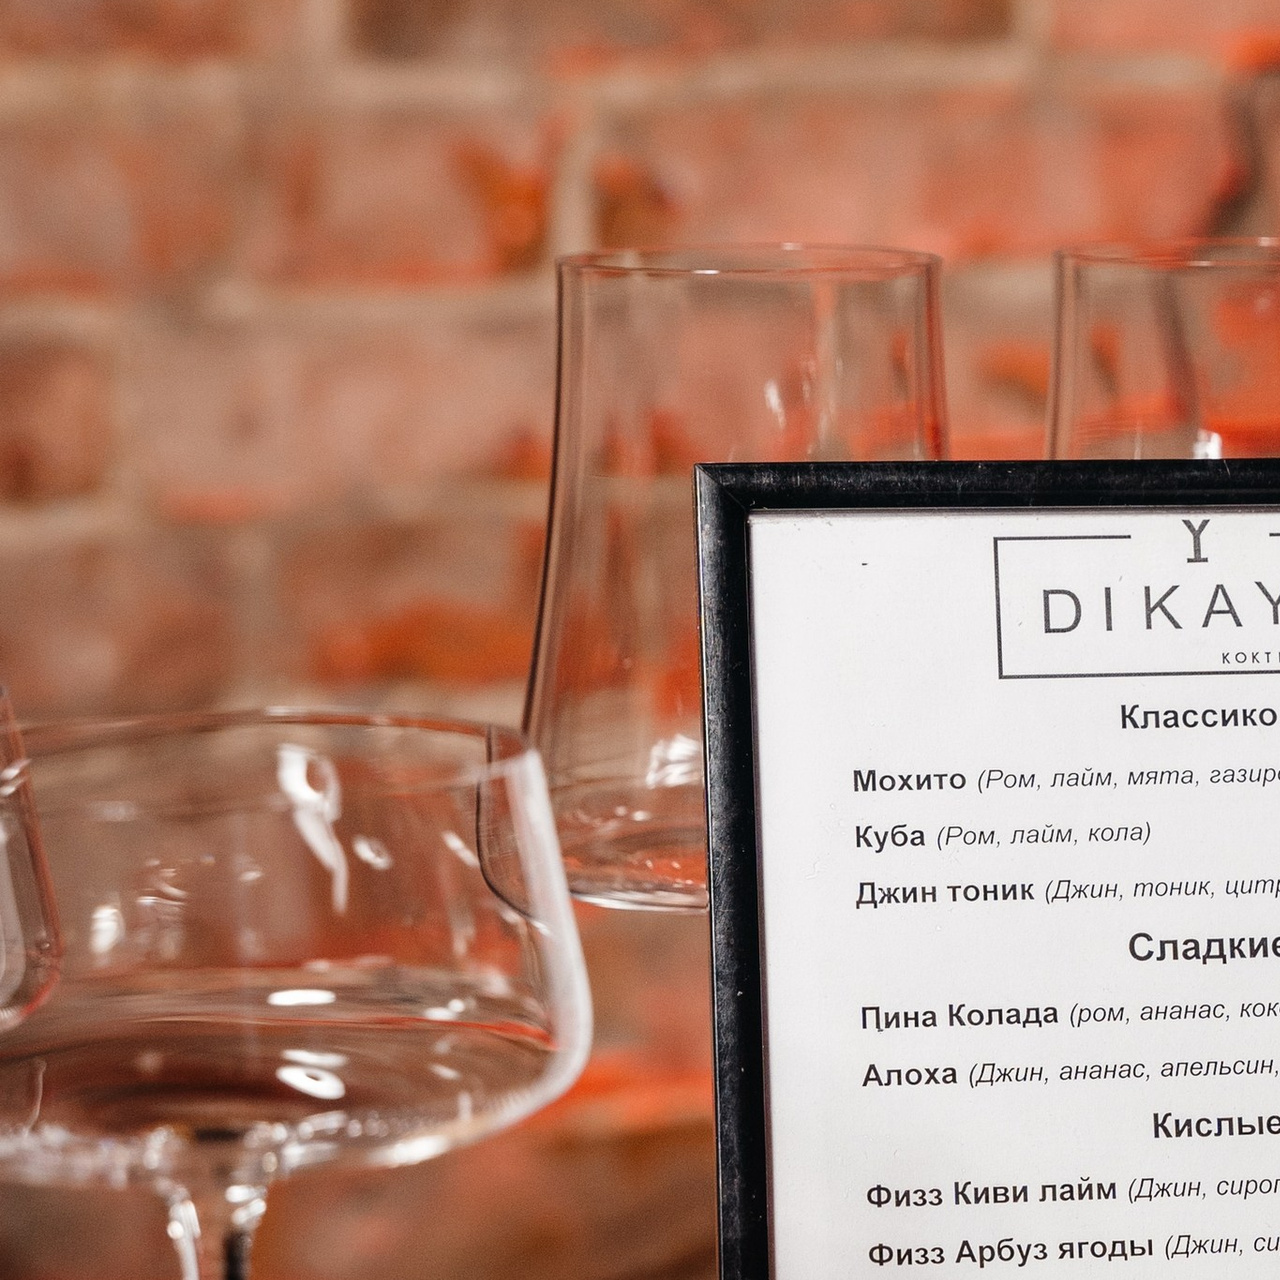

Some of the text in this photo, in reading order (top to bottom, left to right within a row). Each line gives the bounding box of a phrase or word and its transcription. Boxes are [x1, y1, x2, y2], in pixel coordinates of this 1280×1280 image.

[1120, 703, 1278, 730] Классико
[853, 769, 967, 793] Мохито
[977, 769, 1041, 795] (Ром,
[1049, 767, 1118, 790] лайм,
[1126, 768, 1201, 790] мята,
[855, 821, 1151, 854] Куба (Ром, лайм, кола)
[855, 881, 937, 910] Джин
[946, 883, 1035, 903] тоник
[1045, 879, 1123, 905] (Джин,
[1133, 880, 1215, 899] тоник,
[861, 1005, 938, 1033] Пина
[948, 1003, 1059, 1029] Колада
[1069, 1002, 1130, 1028] (ром,
[1139, 1003, 1230, 1023] ананас,
[861, 1063, 958, 1087] Алоха
[968, 1062, 1049, 1089] (Джин,
[1059, 1062, 1150, 1082] ананас,
[1160, 1058, 1279, 1078] апельсин,
[866, 1183, 944, 1209] Физз
[953, 1180, 1029, 1206] Киви
[1038, 1176, 1117, 1203] лайм
[1128, 1177, 1206, 1205] (Джин,
[868, 1242, 946, 1267] Физз
[955, 1237, 1049, 1269] Арбуз
[1057, 1238, 1154, 1262] ягоды
[1165, 1234, 1243, 1261] (Джин,
